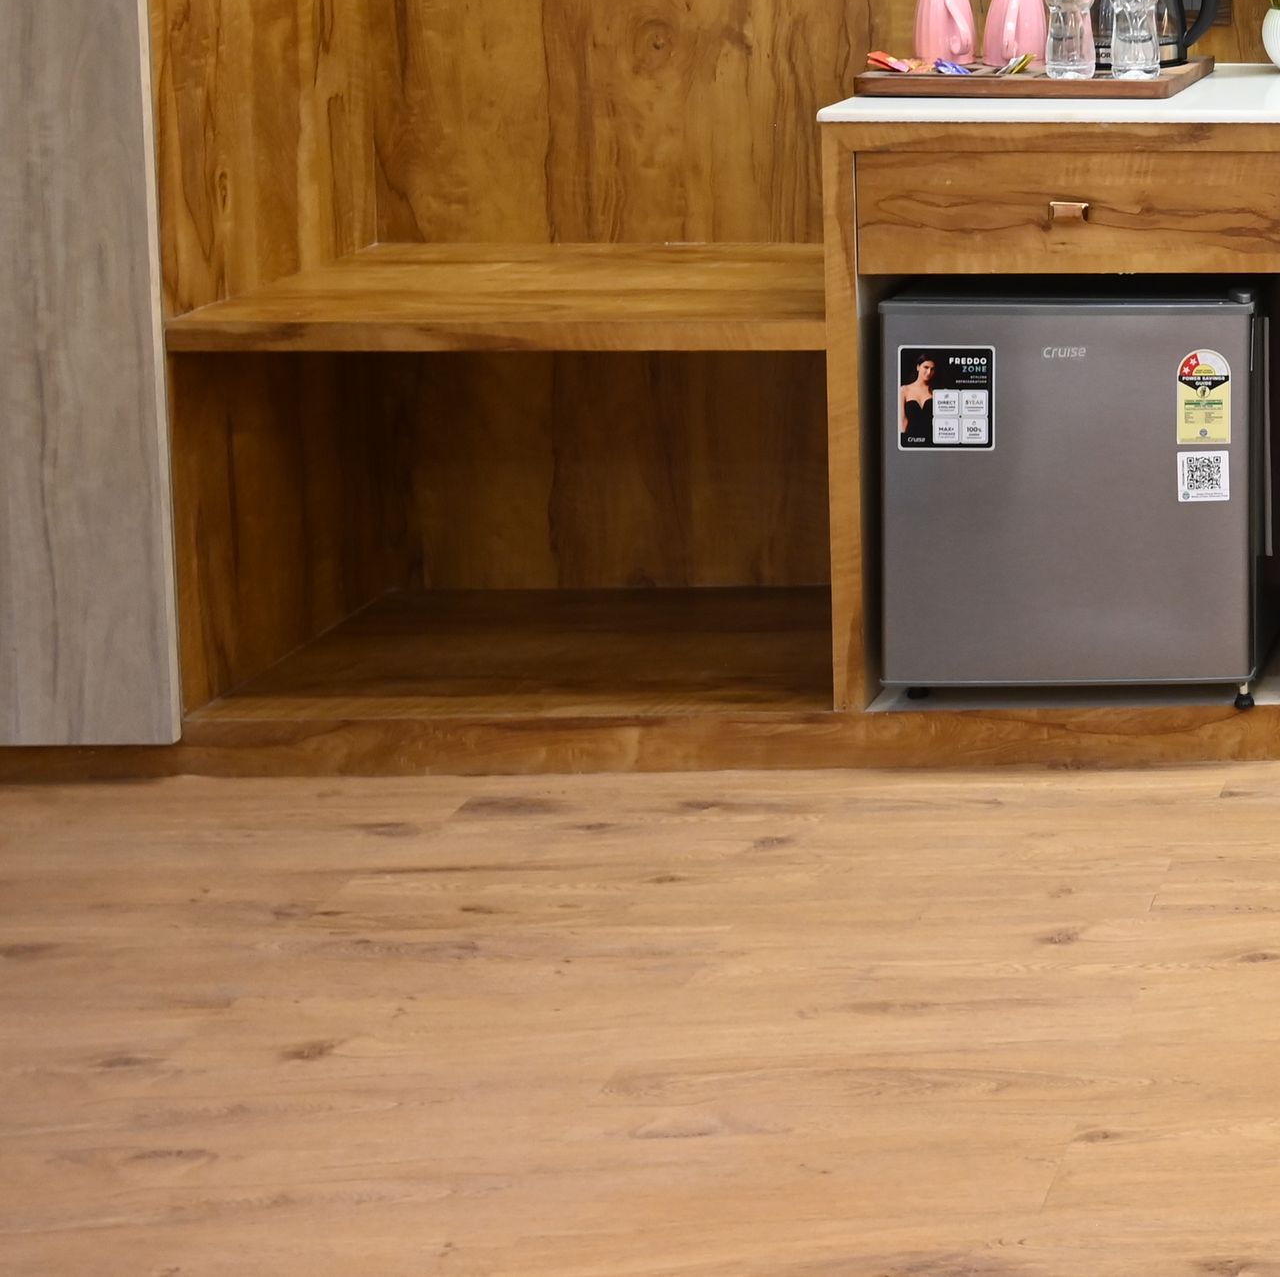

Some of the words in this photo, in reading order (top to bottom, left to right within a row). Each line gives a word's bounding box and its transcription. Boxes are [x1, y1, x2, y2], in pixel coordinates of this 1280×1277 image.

[1043, 346, 1087, 359] Cruise
[948, 357, 988, 365] FREDDO
[962, 365, 987, 373] ZONE
